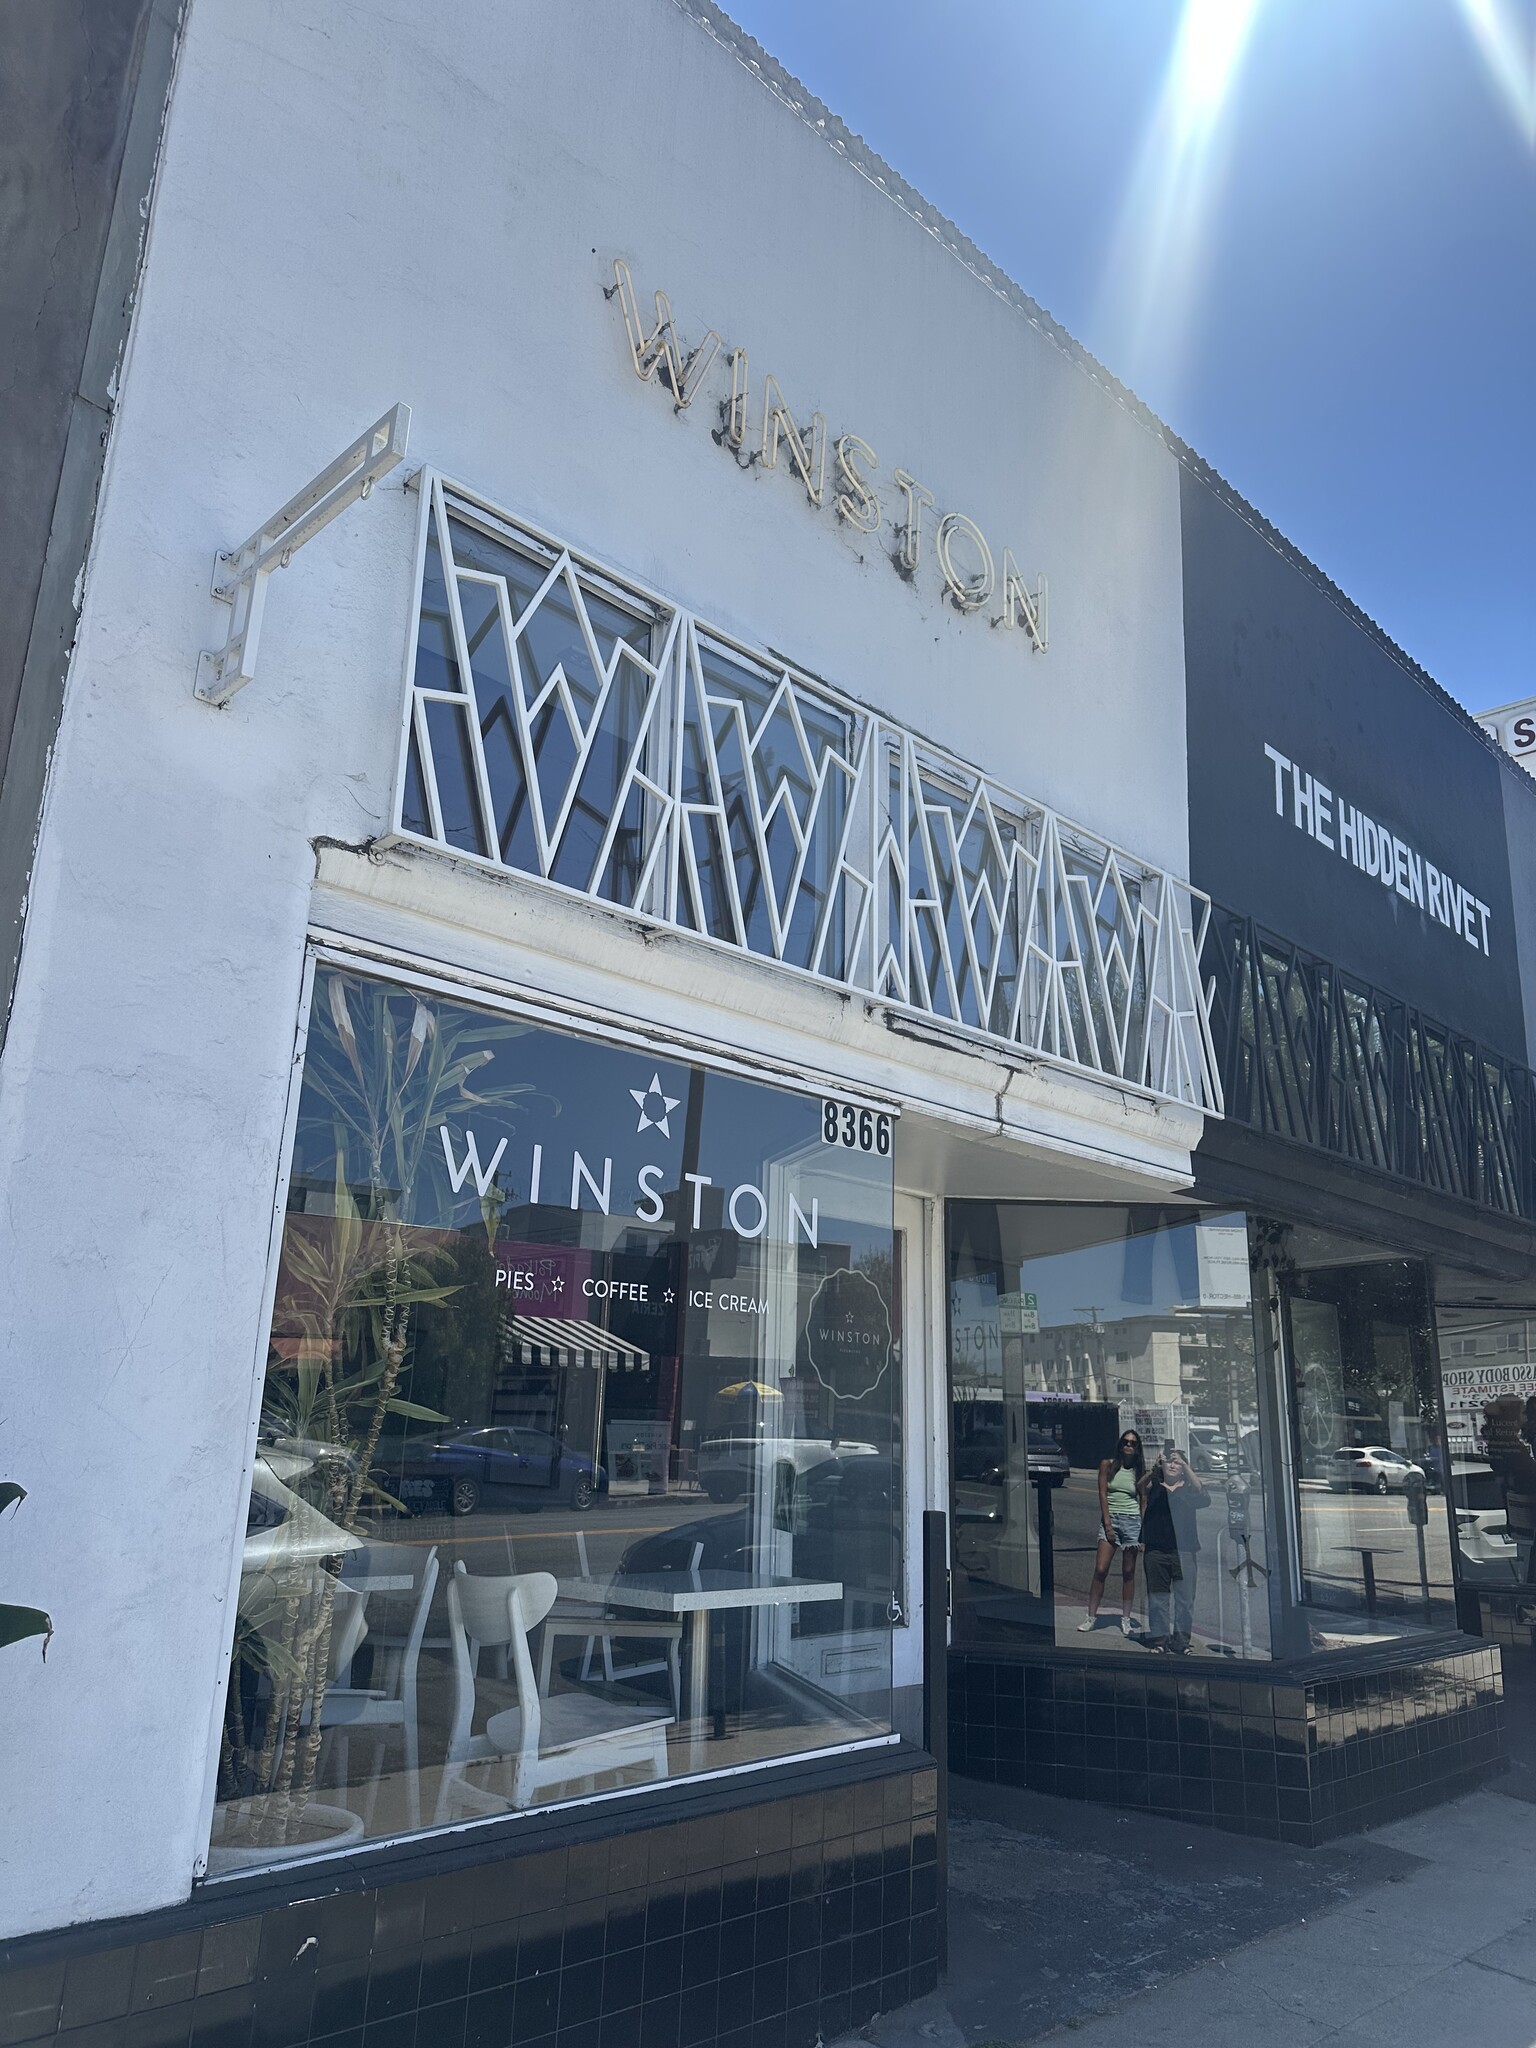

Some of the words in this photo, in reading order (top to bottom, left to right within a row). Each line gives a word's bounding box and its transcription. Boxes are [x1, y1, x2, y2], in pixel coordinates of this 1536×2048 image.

[613, 259, 1048, 653] WINSTON
[1264, 742, 1334, 850] THE
[1338, 797, 1425, 909] HIDDEN
[1425, 860, 1490, 957] RIVET
[823, 1101, 890, 1155] 8366
[440, 1125, 819, 1249] WINSTON
[495, 1269, 535, 1292] PIES
[582, 1278, 649, 1302] COFFEE
[688, 1289, 713, 1309] ICE
[718, 1293, 770, 1315] CREAM
[818, 1327, 880, 1345] WINSTON
